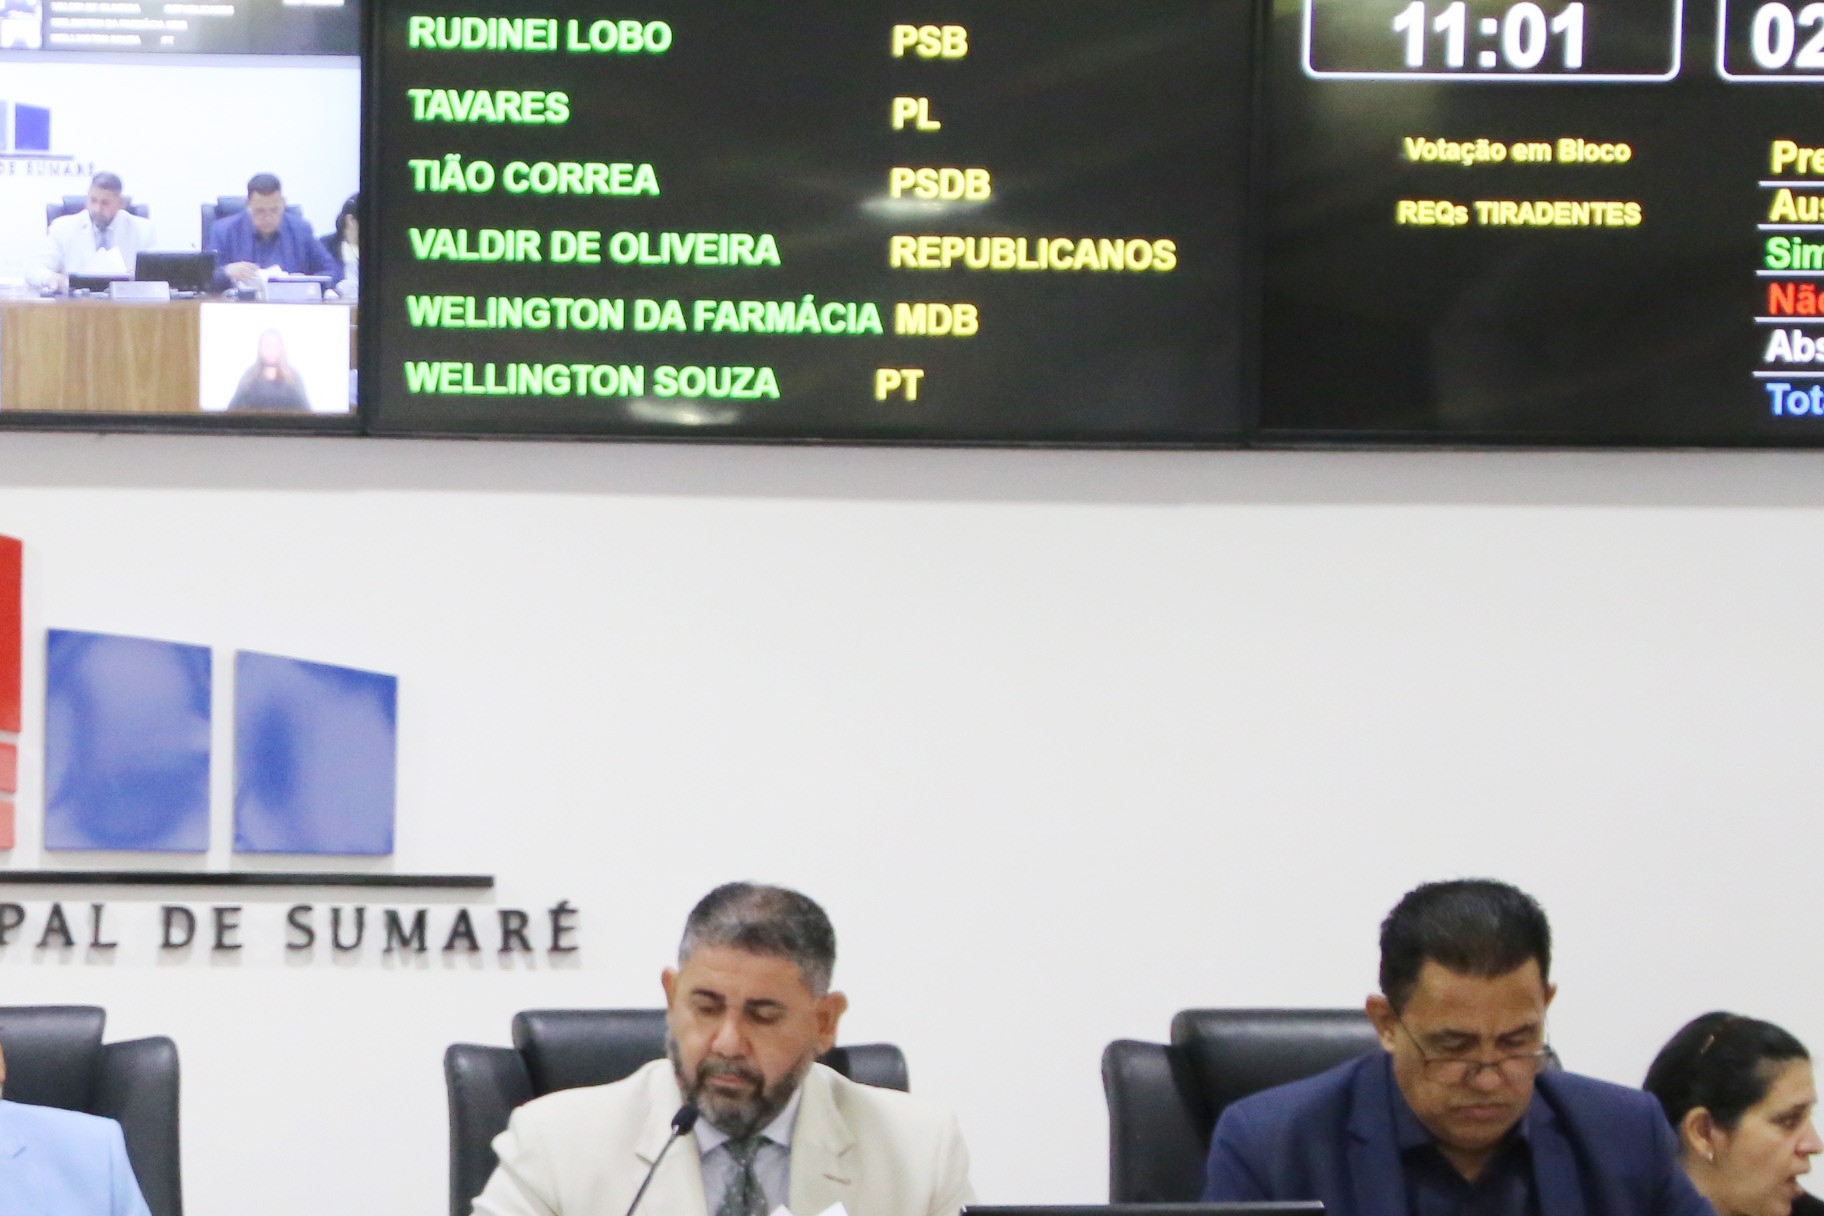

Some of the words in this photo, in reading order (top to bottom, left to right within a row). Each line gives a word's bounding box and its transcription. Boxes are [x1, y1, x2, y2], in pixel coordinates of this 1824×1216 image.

[409, 16, 557, 51] RUDINEI
[567, 20, 672, 53] LOBO
[893, 25, 968, 58] PSB
[1391, 1, 1583, 68] 11:01
[408, 89, 569, 124] TAVARES
[893, 97, 941, 130] PL
[1404, 137, 1507, 166] Votação
[1512, 143, 1552, 161] em
[1557, 138, 1631, 162] Bloco
[408, 154, 495, 192] TIÃO
[503, 162, 660, 196] CORREA
[891, 168, 991, 201] PSDB
[1397, 200, 1468, 225] REQs
[1475, 201, 1641, 226] TIRADENTES
[409, 228, 542, 261] VALDIR
[551, 231, 601, 263] DE
[609, 232, 781, 266] OLIVEIRA
[890, 236, 1176, 270] REPUBLICANOS
[407, 296, 624, 330] WELINGTON
[634, 299, 686, 331] DA
[694, 294, 883, 334] FARMÁCIA
[895, 303, 978, 335] MDB
[405, 362, 644, 397] WELLINGTON
[653, 366, 780, 398] SOUZA
[876, 369, 924, 400] PT
[161, 904, 243, 949] DE
[286, 901, 580, 953] SUMARÉ
